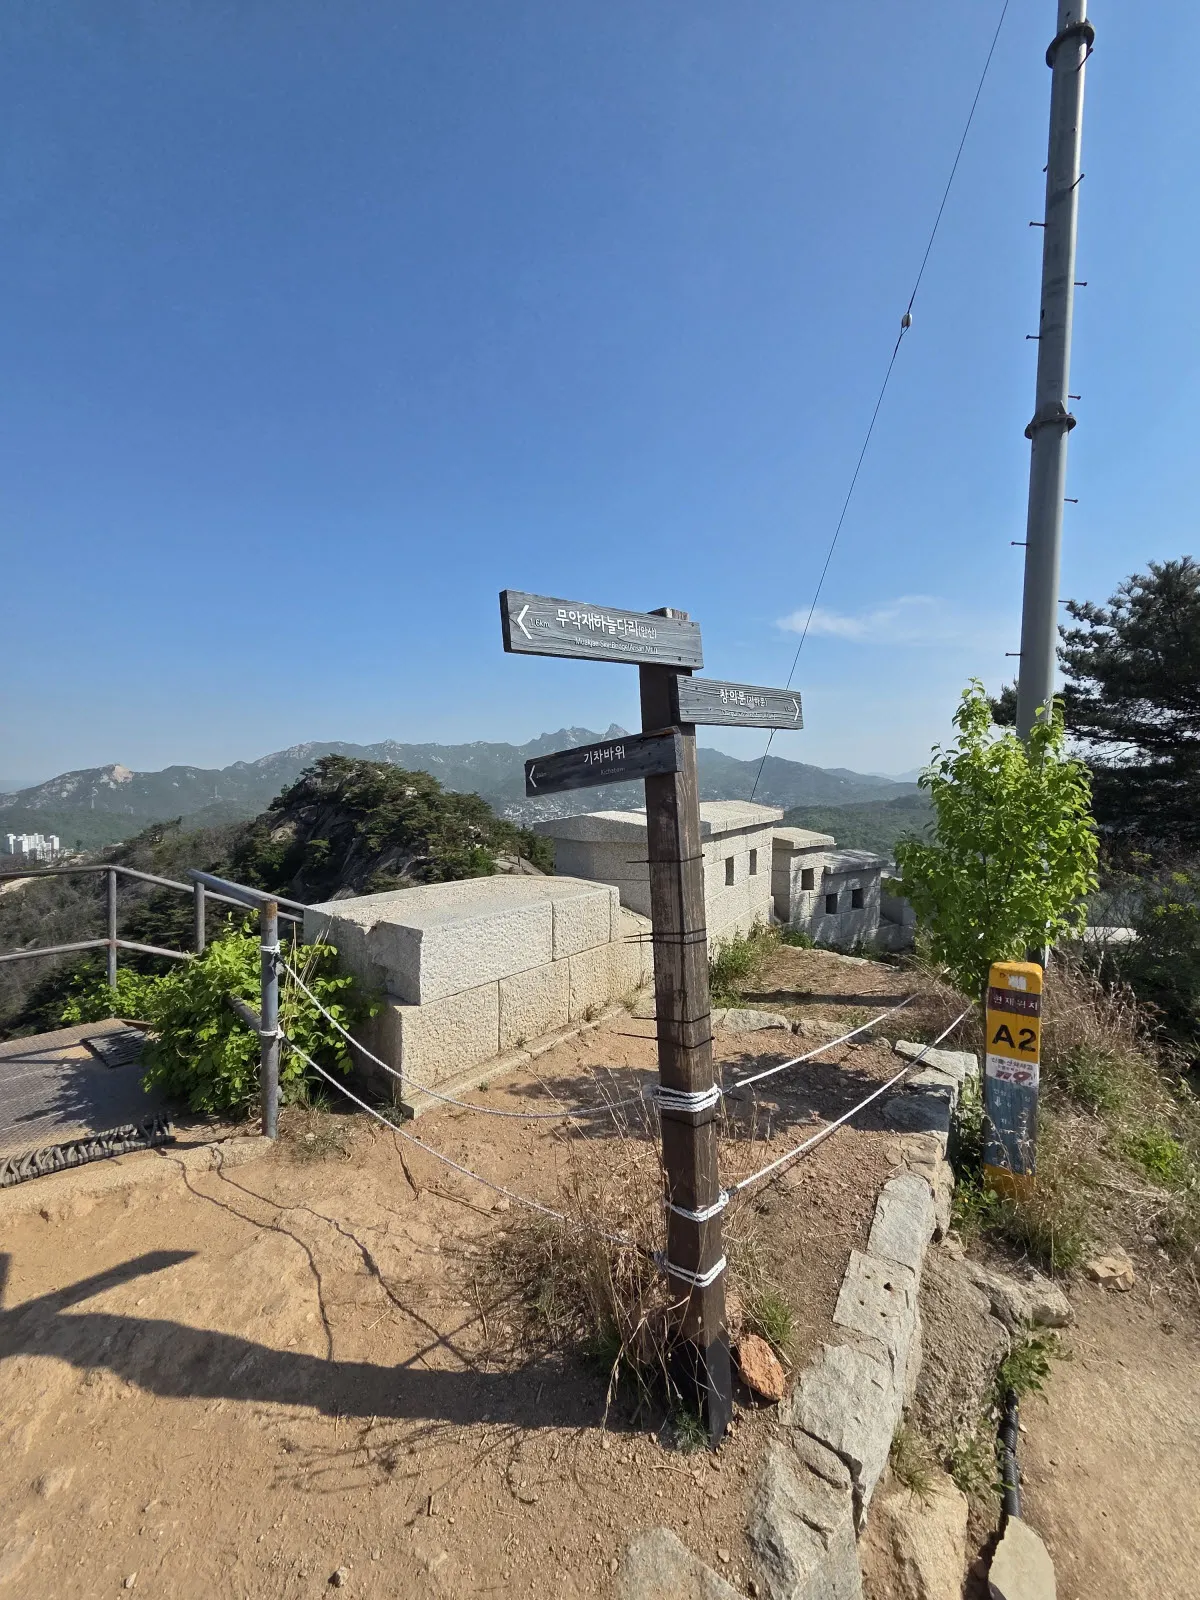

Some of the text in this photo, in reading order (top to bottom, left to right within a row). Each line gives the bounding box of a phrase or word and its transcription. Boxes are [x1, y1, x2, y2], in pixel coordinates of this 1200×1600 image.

[556, 609, 657, 639] 무악재하늘다리(안산)
[583, 745, 625, 765] 기차바위
[992, 1024, 1036, 1053] A2
